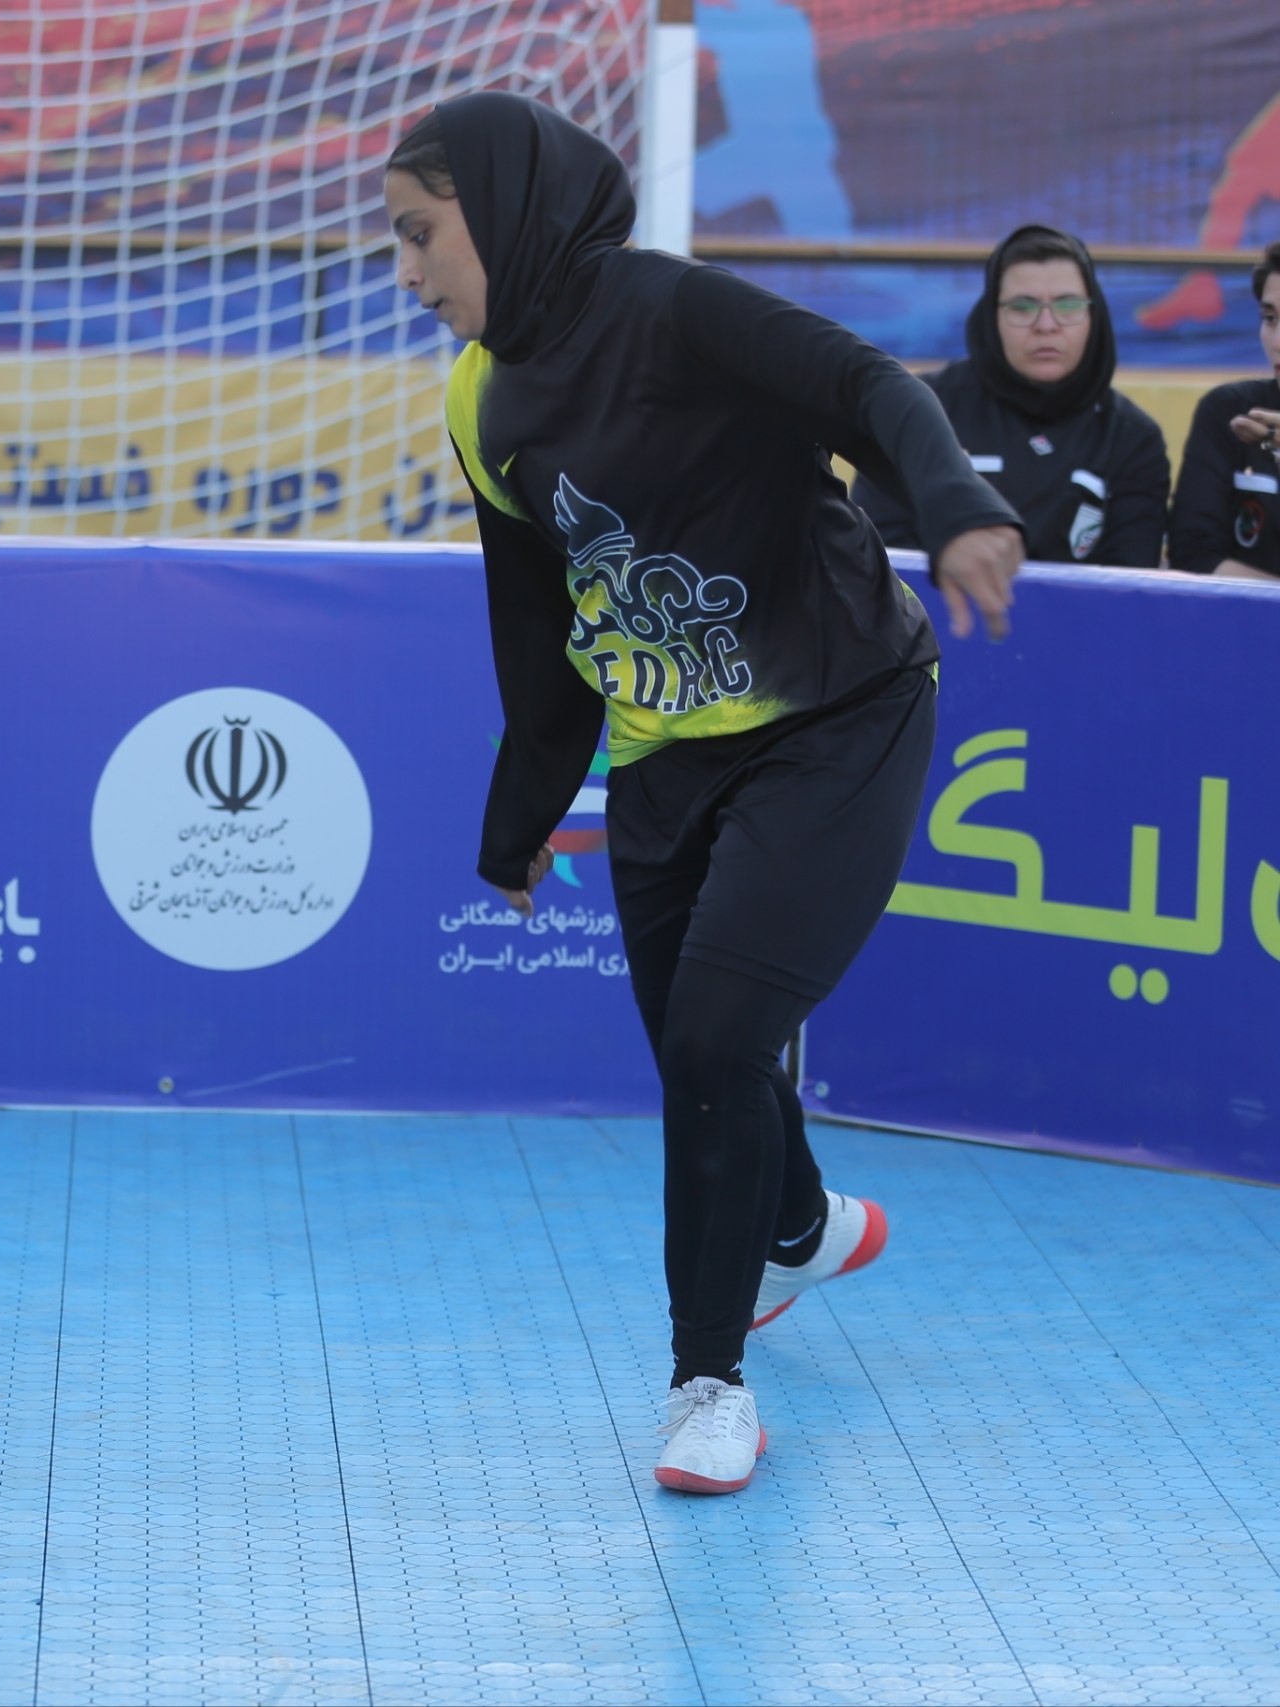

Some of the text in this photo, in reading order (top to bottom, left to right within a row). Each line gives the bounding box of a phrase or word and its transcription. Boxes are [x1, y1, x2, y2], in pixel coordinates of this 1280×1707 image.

[439, 901, 522, 933] همگانی
[438, 942, 513, 974] ایران
[517, 946, 595, 974] اسلامی
